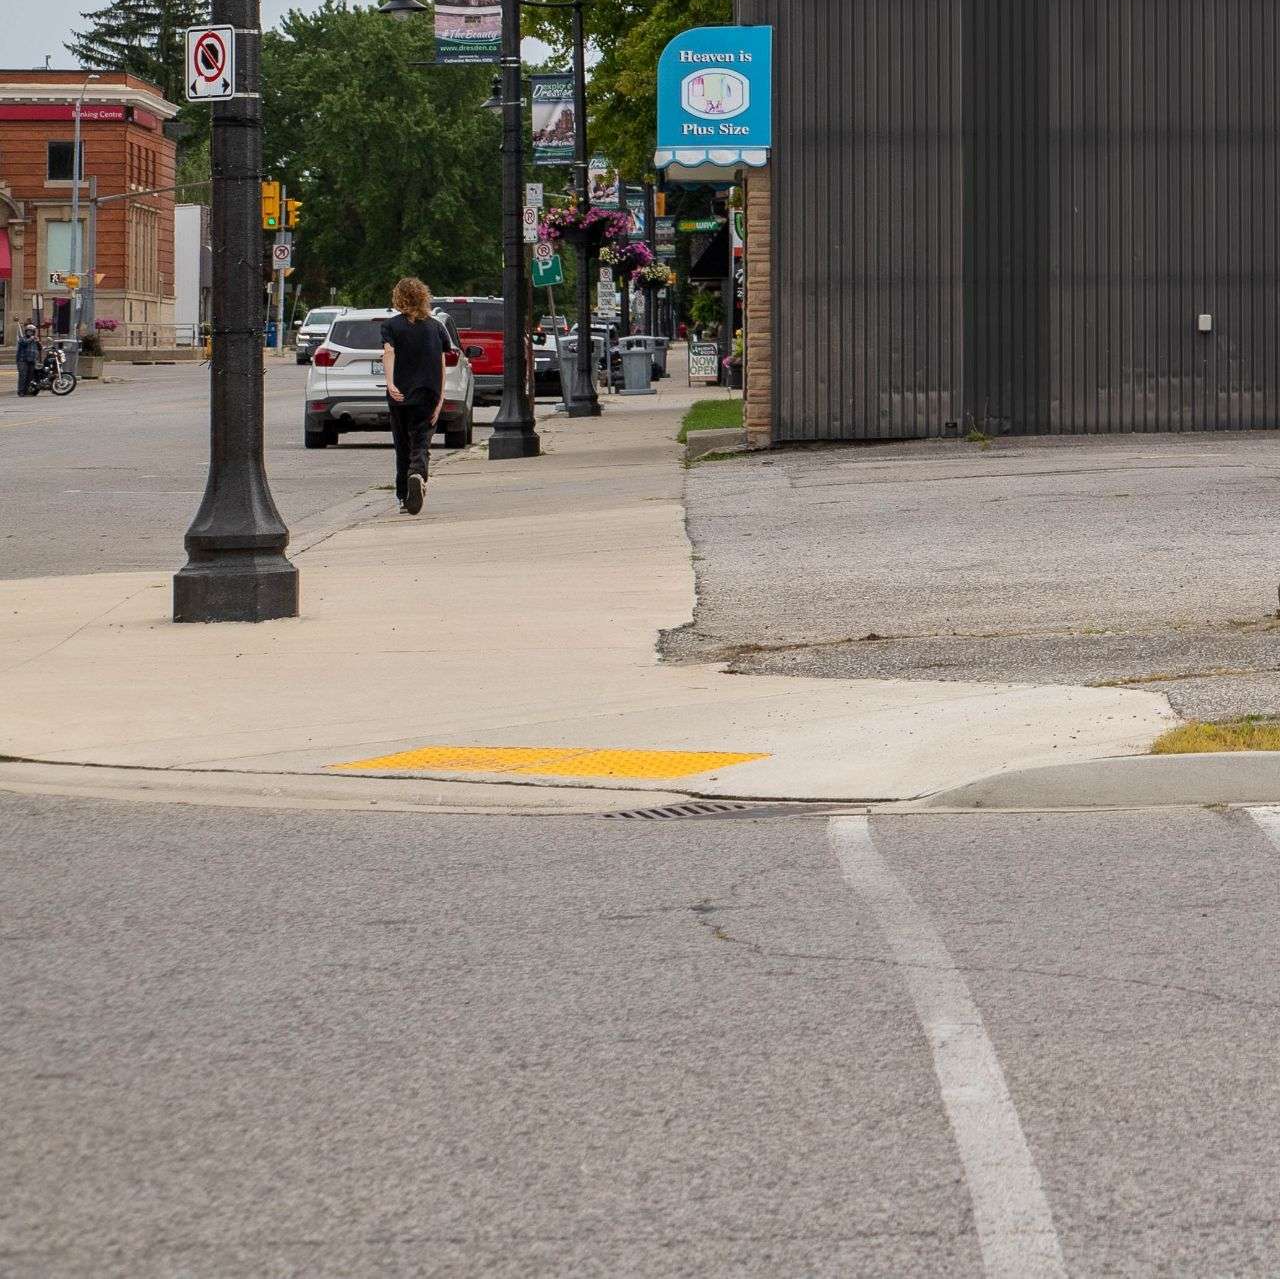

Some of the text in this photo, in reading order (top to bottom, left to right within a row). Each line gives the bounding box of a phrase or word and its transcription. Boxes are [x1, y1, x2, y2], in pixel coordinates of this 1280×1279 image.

[680, 50, 753, 62] Heaven is
[72, 110, 123, 119] Bnking Centre
[681, 123, 750, 135] Plus Size
[692, 356, 715, 366] NOW
[690, 365, 716, 375] OPEN
